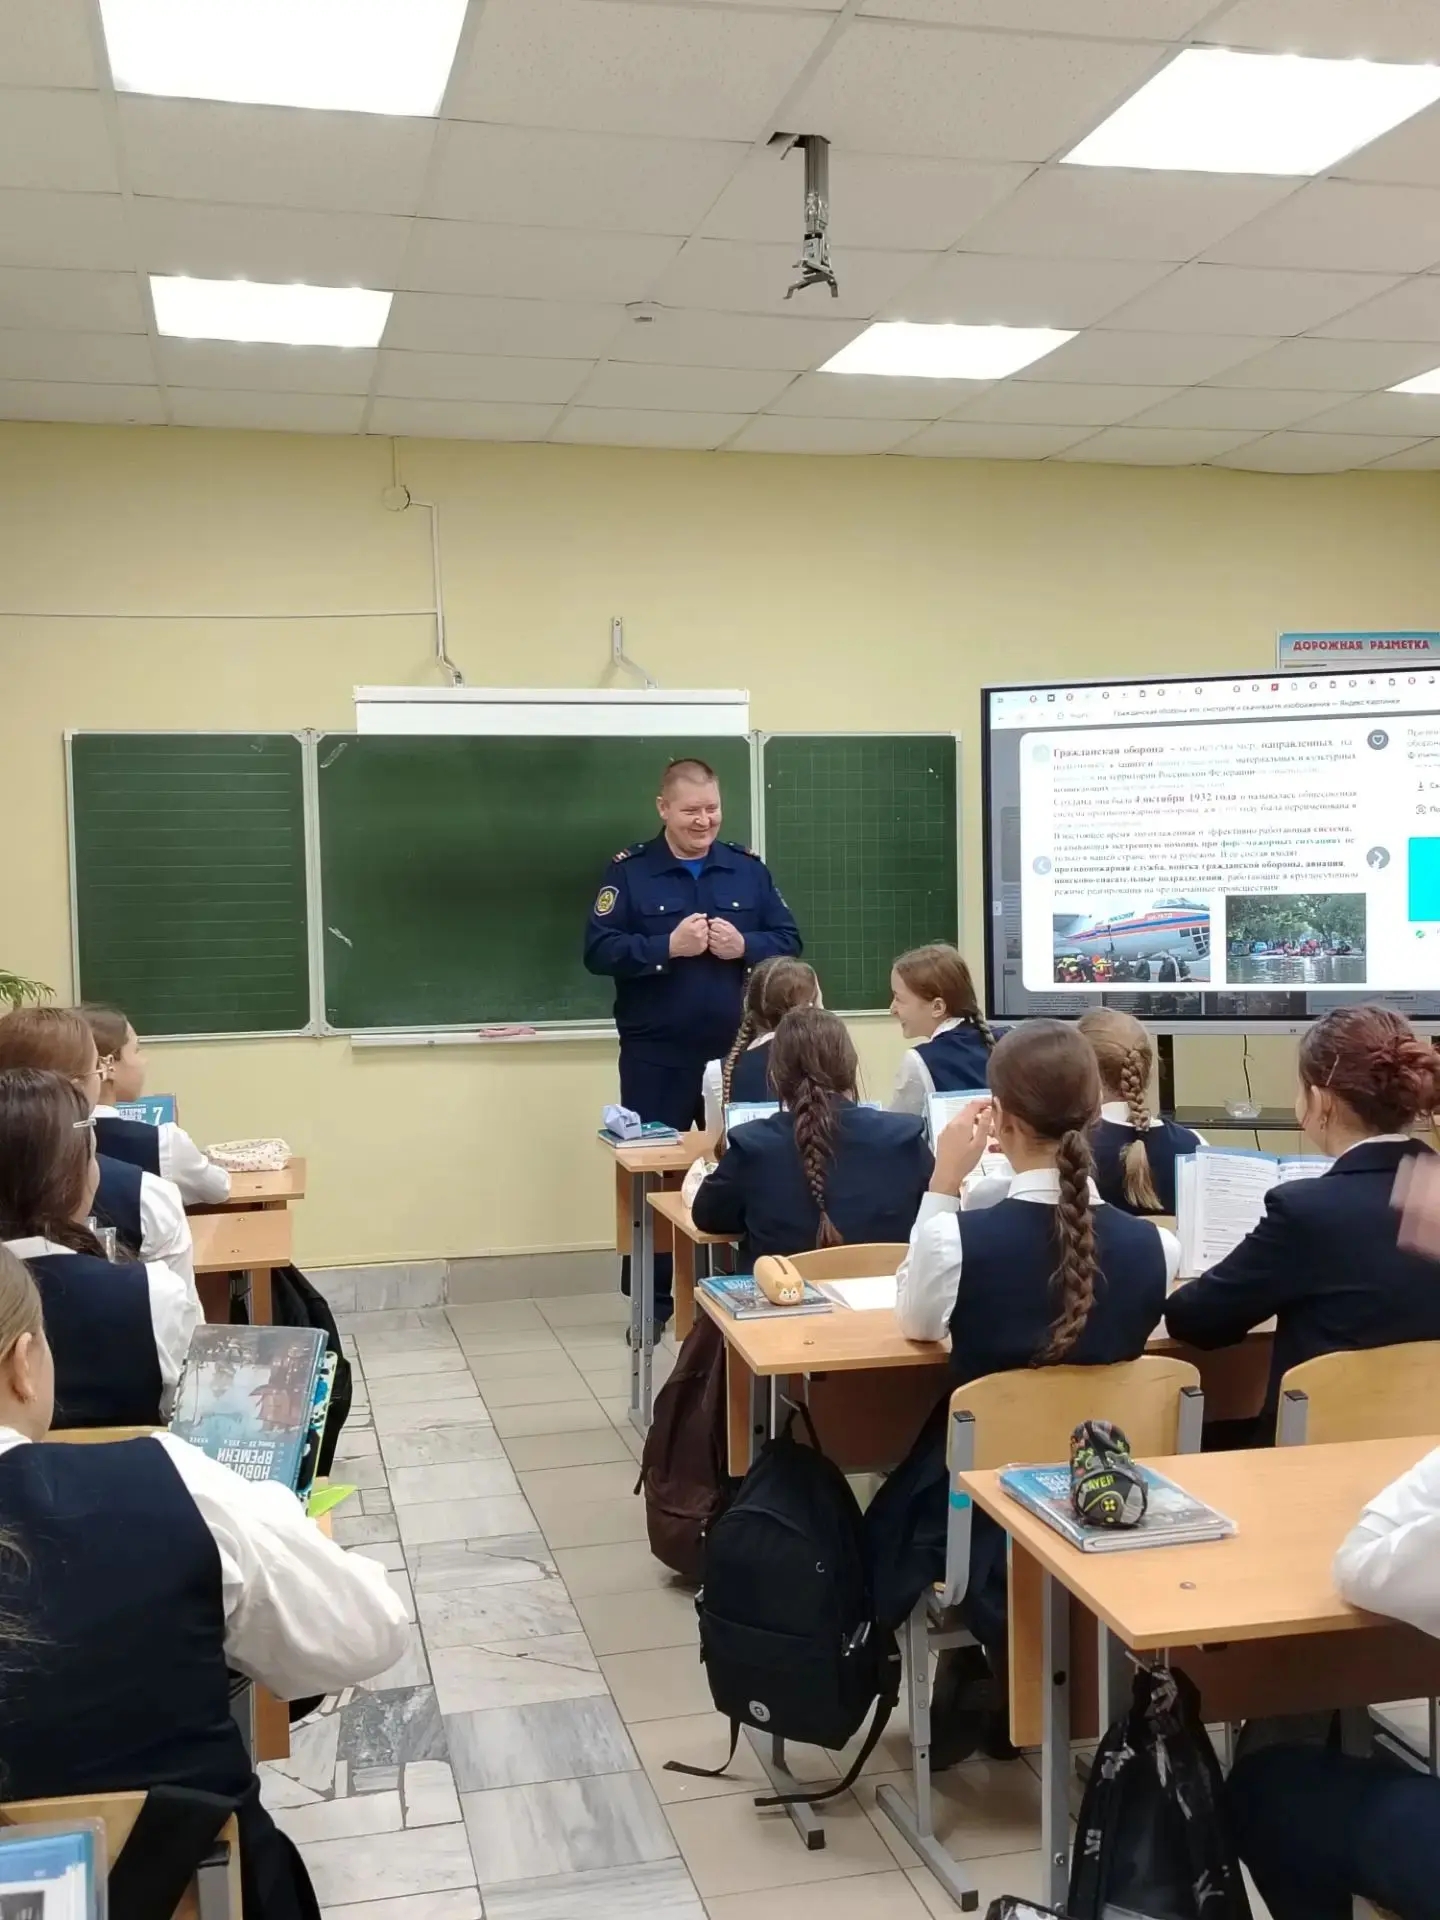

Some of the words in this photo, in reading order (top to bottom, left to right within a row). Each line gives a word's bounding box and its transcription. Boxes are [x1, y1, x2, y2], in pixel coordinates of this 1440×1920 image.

[1293, 640, 1363, 651] ДОРОЖНАЯ
[1370, 639, 1430, 650] РАЗМЕТКА
[1053, 747, 1120, 760] Гражданская
[1124, 745, 1165, 757] оборона
[1261, 740, 1334, 753] направленных
[1189, 792, 1212, 802] 1932
[1201, 861, 1260, 872] гражданской
[152, 1106, 164, 1126] 7
[217, 1447, 274, 1465] ВРЕМЕНИ
[225, 1463, 271, 1480] НОВОГ
